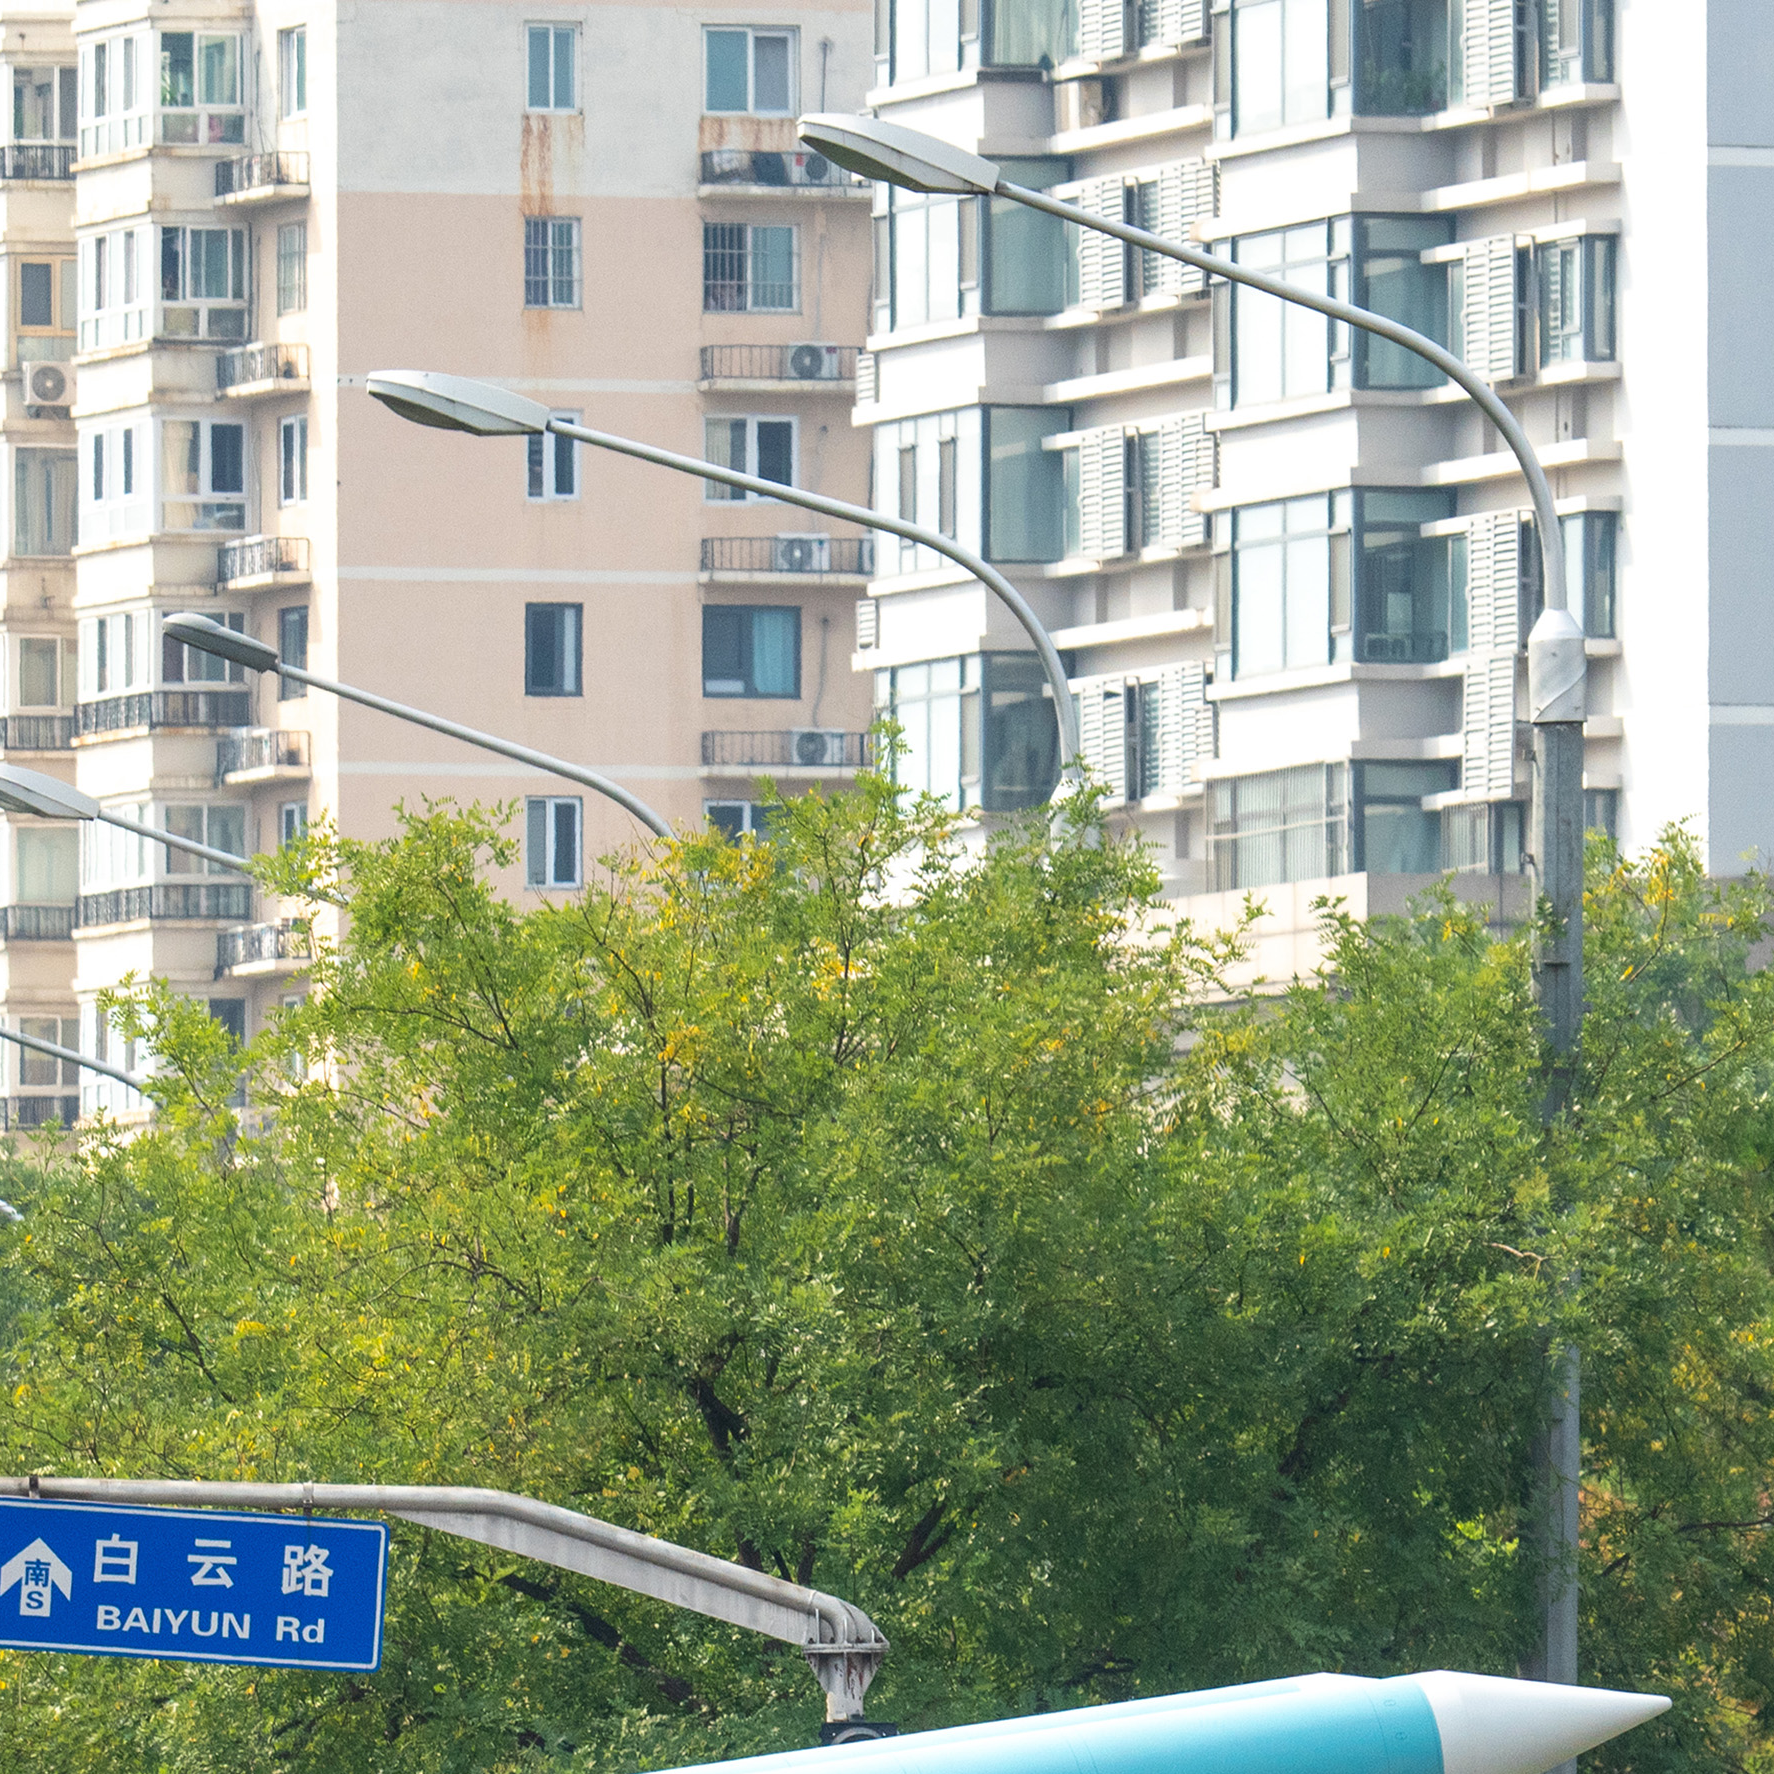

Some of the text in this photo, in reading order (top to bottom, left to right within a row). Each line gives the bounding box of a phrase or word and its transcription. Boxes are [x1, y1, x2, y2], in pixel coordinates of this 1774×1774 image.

[24, 1558, 51, 1588] 南
[93, 1533, 334, 1597] 白云路
[25, 1590, 44, 1609] S
[96, 1605, 326, 1643] BAIYUN Rd
